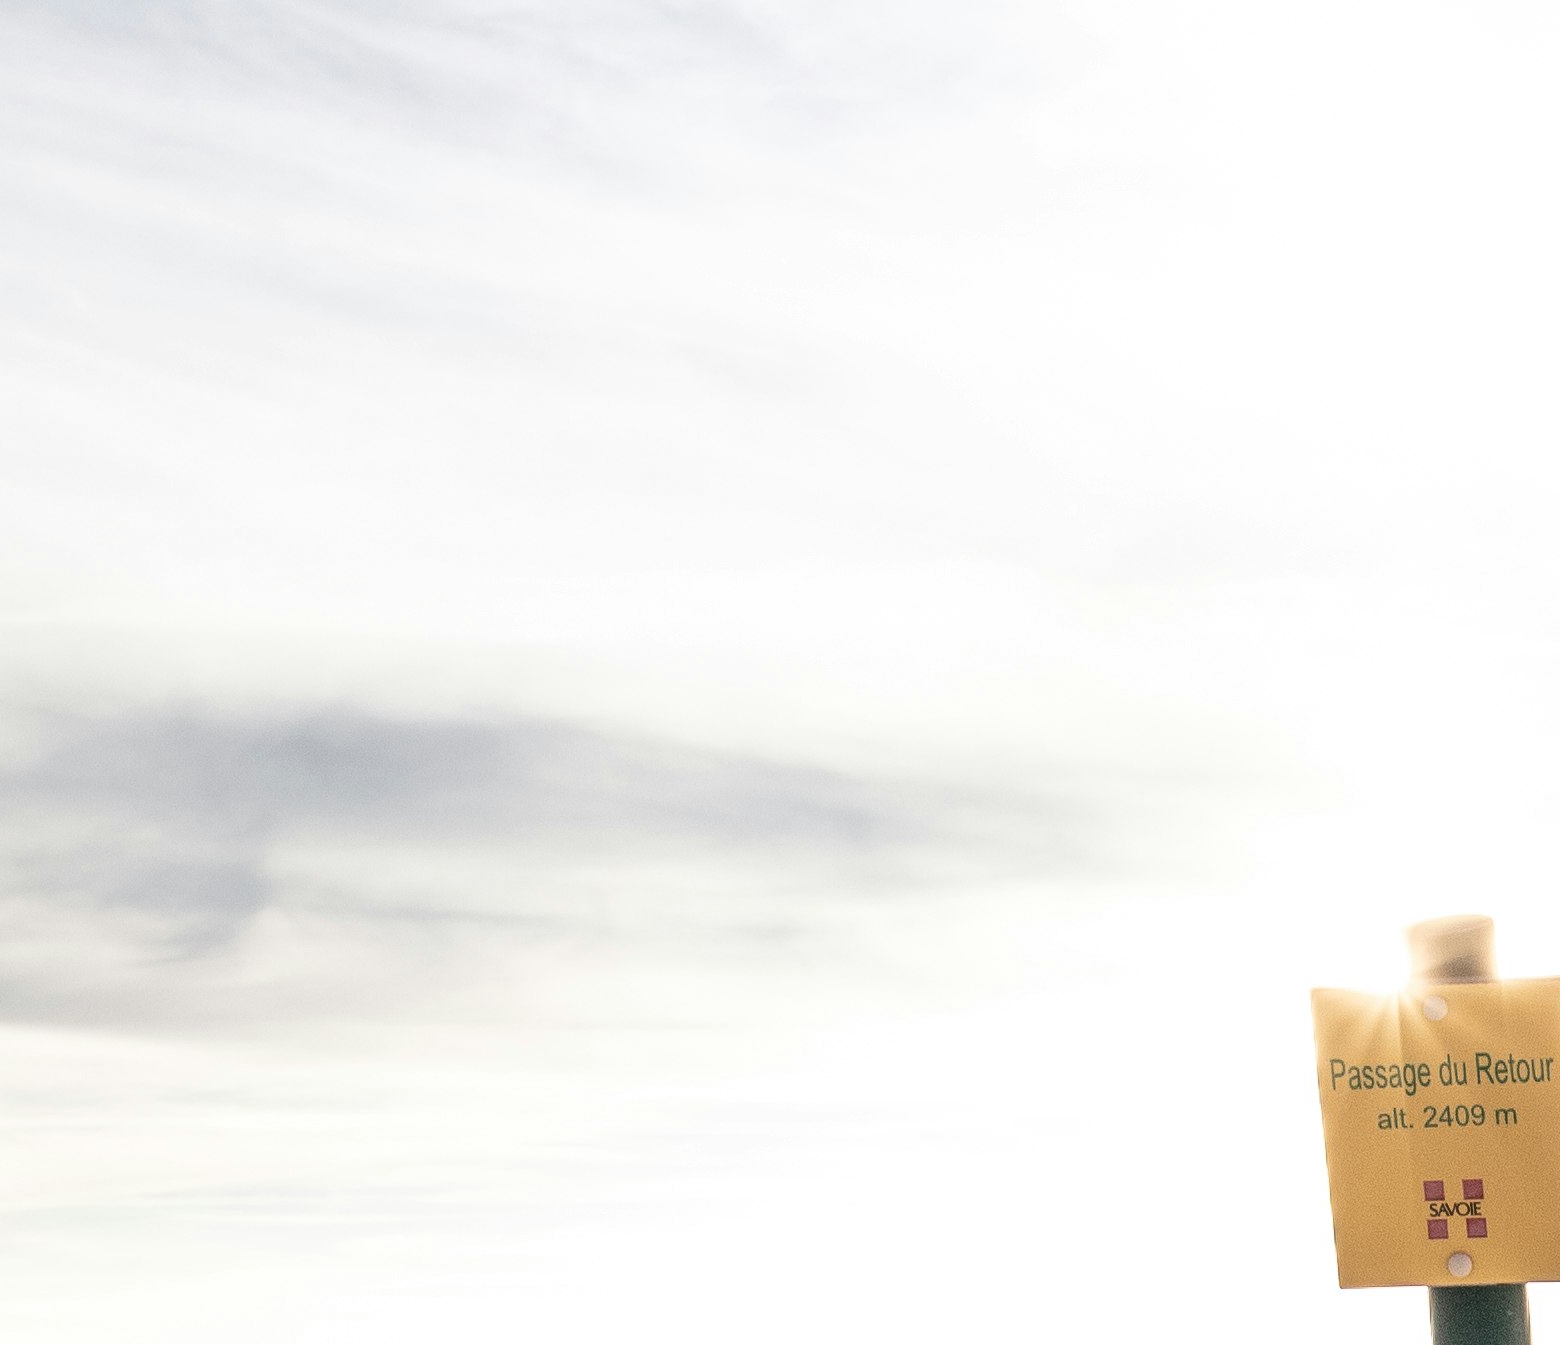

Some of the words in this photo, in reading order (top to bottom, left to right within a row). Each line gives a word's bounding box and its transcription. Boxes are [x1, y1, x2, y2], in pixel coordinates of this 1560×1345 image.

[1329, 1057, 1432, 1097] Passage
[1440, 1053, 1468, 1088] du
[1475, 1051, 1554, 1085] Retour
[1378, 1107, 1414, 1131] alt.
[1423, 1104, 1486, 1129] 2409
[1495, 1105, 1519, 1126] m
[1429, 1201, 1483, 1218] SAVOIE
